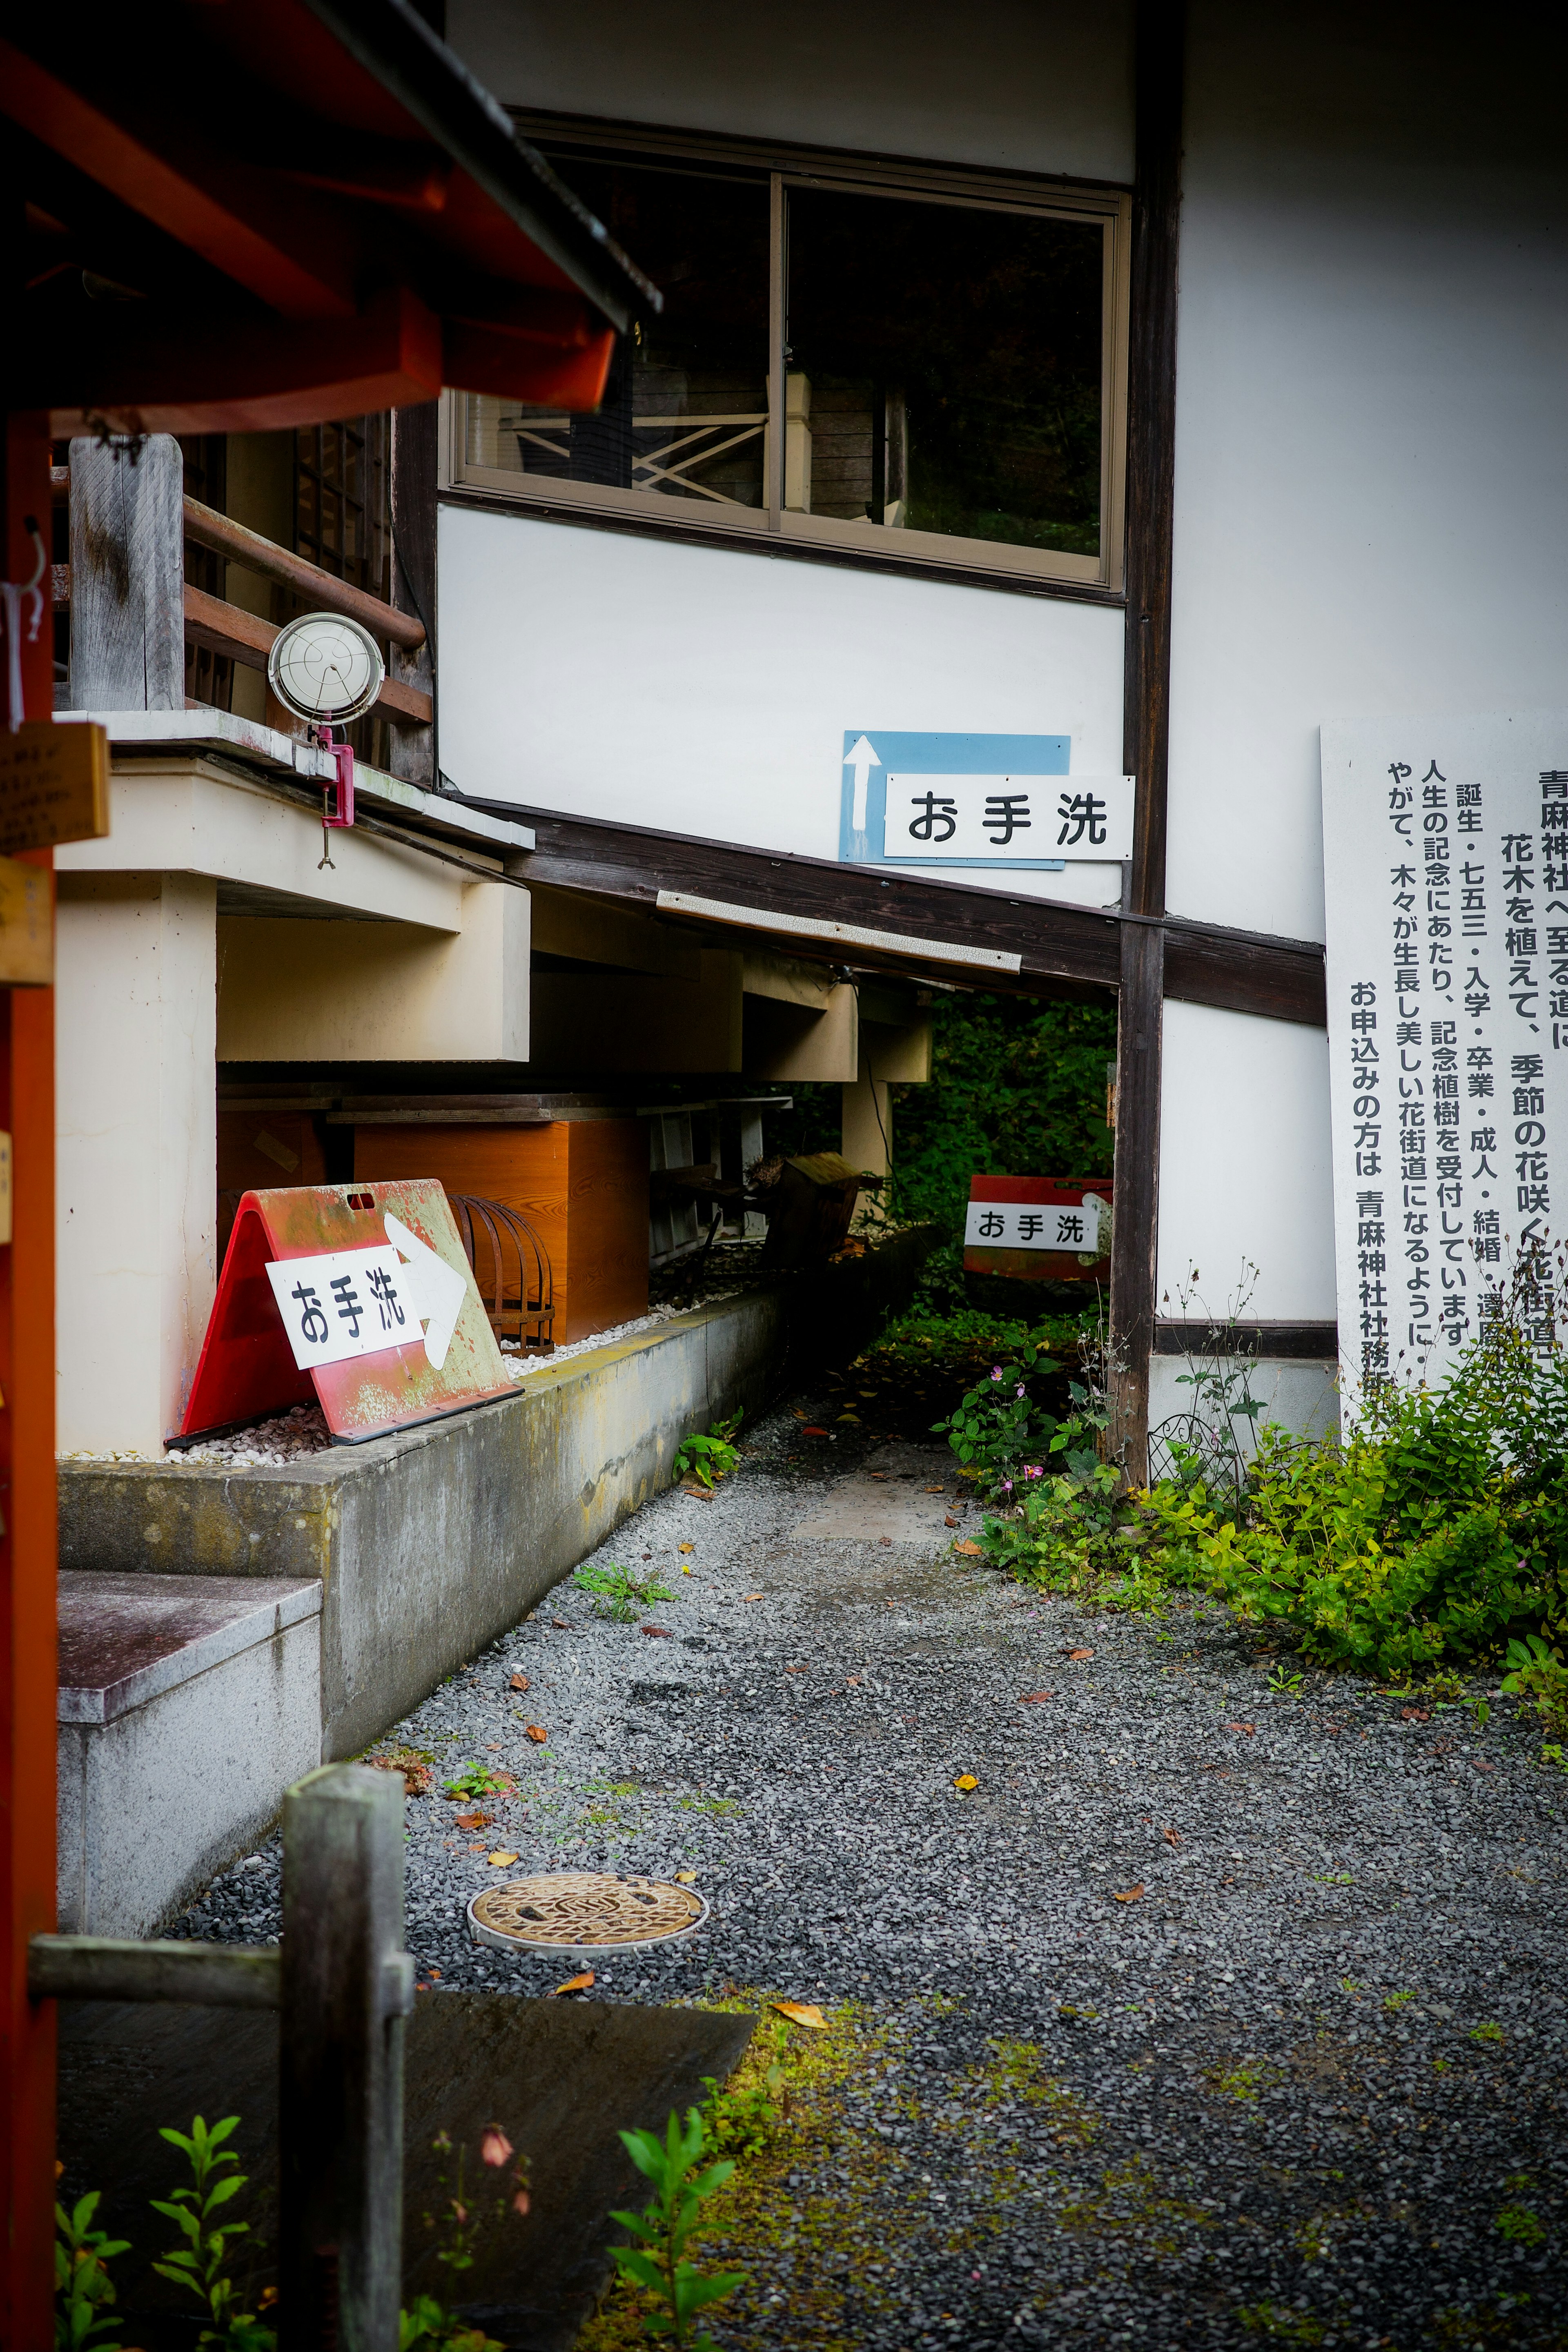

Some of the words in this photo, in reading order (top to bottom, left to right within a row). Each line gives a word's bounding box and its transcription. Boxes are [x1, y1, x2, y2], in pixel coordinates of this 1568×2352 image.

[909, 791, 1107, 845] お手洗
[1351, 982, 1382, 1176] お申込みの方は
[1421, 760, 1470, 1360] 人生の記念にあたり、記念植樹を受付しています。
[1456, 783, 1505, 1392] 誕生・七五三・入学・卒業・成人・結婚・還暦
[1501, 834, 1555, 1400] 花木を植えて、季節の花咲く花街道に
[292, 1267, 405, 1343] お手洗
[978, 1211, 1084, 1243] お手洗
